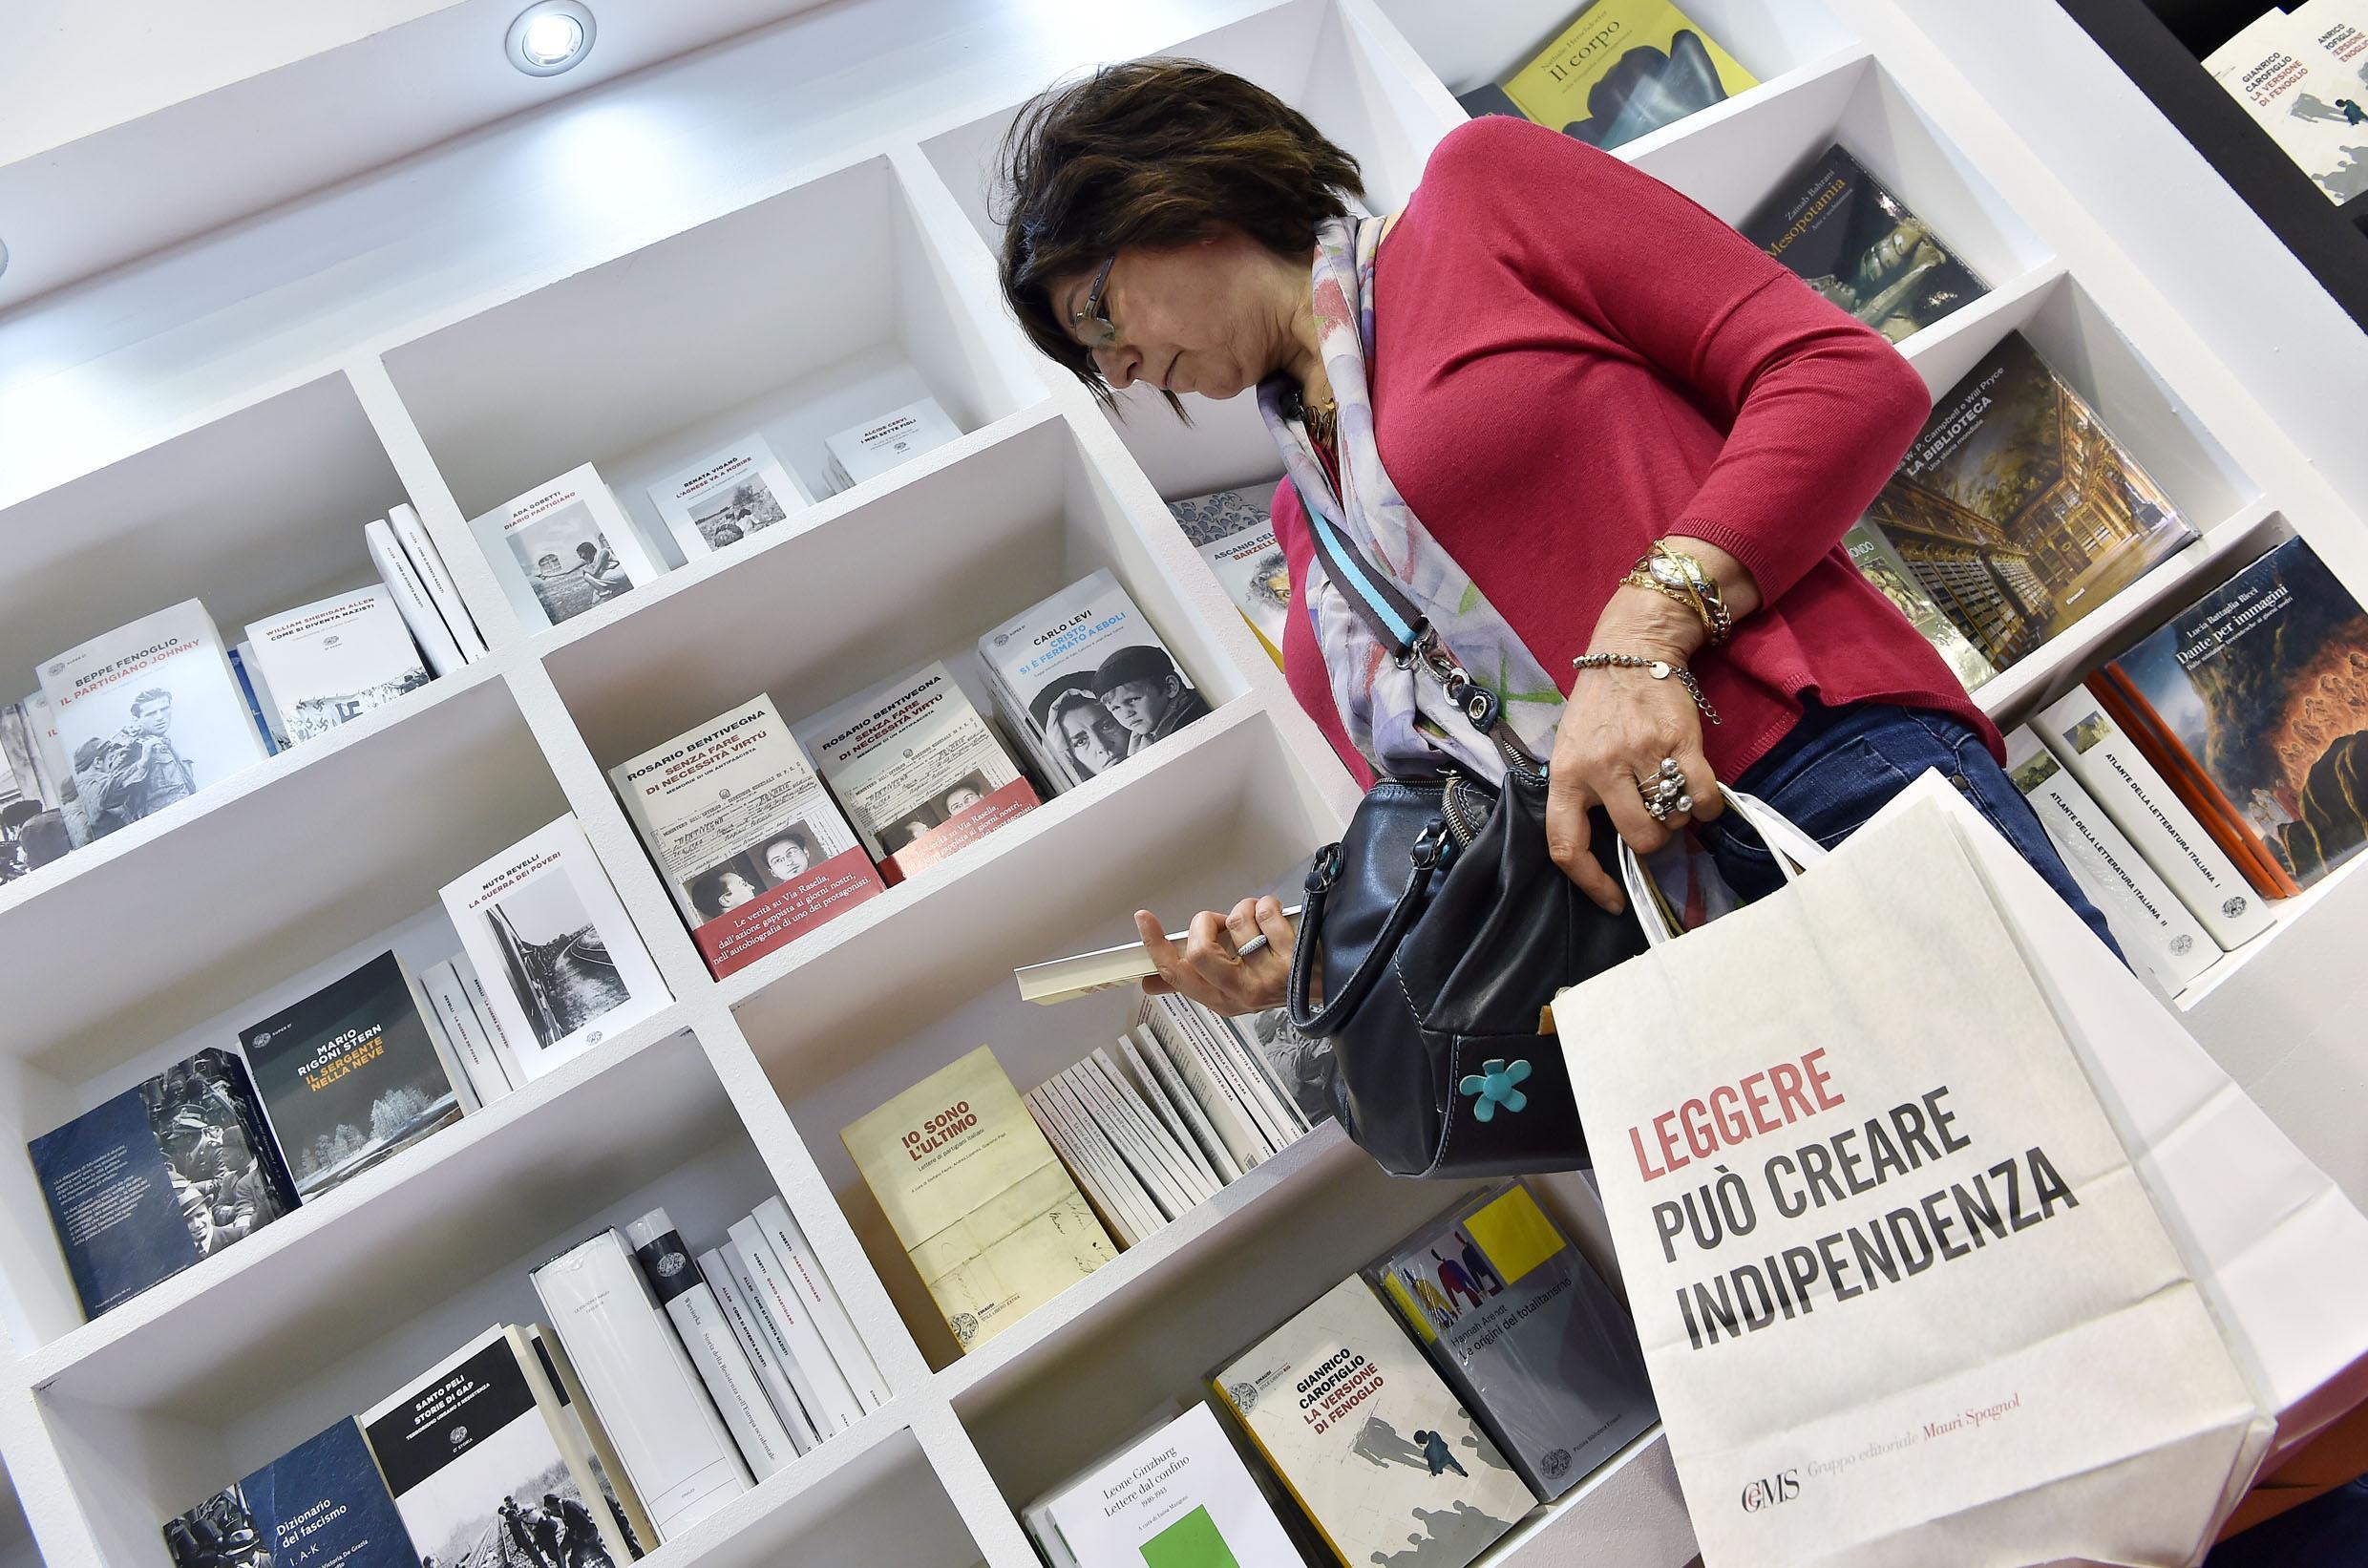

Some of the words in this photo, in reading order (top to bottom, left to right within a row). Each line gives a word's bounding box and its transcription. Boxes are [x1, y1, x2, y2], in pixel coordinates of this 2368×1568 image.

[1551, 65, 1568, 81] Il
[1570, 21, 1619, 67] corpo
[2242, 52, 2281, 83] GIANRICO
[2245, 55, 2293, 93] CAROFIGLIO
[2250, 91, 2264, 101] LA
[2262, 60, 2303, 92] VERSIONE
[2259, 98, 2271, 107] DI
[2270, 68, 2309, 102] FENOGLIO
[1905, 452, 1916, 461] W.
[1924, 408, 1960, 443] Campbell
[1965, 389, 1981, 403] Will
[1980, 368, 2004, 390] Pryce
[1907, 460, 1924, 477] LA
[1923, 396, 1993, 461] BIBLIOTECA
[676, 479, 708, 498] L'AGNESE
[726, 457, 751, 472] MORIRE
[684, 472, 710, 487] RENATA
[503, 514, 529, 530] DIARIO
[531, 492, 575, 516] PARTIGIANO
[513, 508, 528, 518] ADA
[529, 491, 560, 508] GOBETTI
[1214, 540, 1255, 561] ASCANIO
[265, 621, 302, 636] WILLIAM
[304, 606, 346, 623] SHERIDAN
[348, 598, 374, 608] ALLEN
[270, 629, 293, 641] COME
[305, 615, 340, 628] DIVENTA
[342, 604, 374, 616] NAZISTI
[1033, 624, 1067, 646] CARLO
[1068, 610, 1091, 625] LEVI
[2175, 637, 2213, 665] Dante
[2212, 623, 2234, 643] per
[2232, 583, 2289, 626] immagini
[2187, 623, 2209, 638] Lucia
[2207, 601, 2239, 625] Battaglia
[2238, 586, 2258, 604] Ricci
[1020, 665, 1030, 674] SI
[1031, 660, 1039, 668] È
[1039, 633, 1086, 663] FERMATO
[1096, 612, 1126, 631] EBOLI
[1050, 625, 1086, 647] CRISTO
[60, 697, 72, 706] IL
[74, 661, 147, 699] PARTIGIANO
[152, 638, 199, 664] JOHNNY
[74, 665, 114, 688] BEPPE
[116, 638, 178, 667] FENOGLIO
[48, 729, 57, 737] IL
[822, 718, 871, 751] ROSARIO
[873, 676, 941, 719] BENTIVEGNA
[838, 751, 851, 760] DI
[852, 714, 911, 752] NECESSITÀ
[855, 718, 891, 742] SENZA
[891, 700, 920, 719] FARE
[626, 750, 684, 781] ROSARIO
[686, 710, 766, 752] BENTIVEGNA
[665, 752, 707, 775] SENZA
[708, 733, 740, 753] FARE
[645, 784, 660, 795] DI
[661, 750, 729, 787] NECESSITÀ
[2105, 752, 2132, 784] ATLANTE
[2130, 782, 2150, 806] DELLA
[2149, 805, 2189, 853] LETTERATURA
[2188, 851, 2215, 883] ITALIANA
[468, 900, 479, 908] LA
[481, 879, 514, 901] GUERRA
[516, 869, 529, 880] DEI
[531, 851, 560, 872] POVERI
[482, 875, 504, 890] NUTO
[506, 854, 539, 876] REVELLI
[2050, 792, 2078, 821] ATLANTE
[2076, 820, 2095, 844] DELLA
[2094, 842, 2135, 890] LETTERATURA
[2133, 888, 2161, 920] ITALIANA
[712, 924, 781, 964] nell'autobiografia
[782, 917, 792, 926] di
[792, 910, 808, 922] uno
[809, 902, 821, 912] dei
[822, 878, 871, 907] protagonisti.
[718, 923, 761, 950] dall'azione
[762, 905, 794, 927] gappista
[795, 898, 804, 907] ai
[805, 885, 829, 906] giorni
[830, 872, 856, 889] nostri,
[733, 919, 746, 927] Le
[747, 904, 771, 921] verità
[772, 900, 782, 908] su
[781, 891, 797, 901] Via
[797, 876, 829, 894] Rasella,
[297, 1047, 341, 1075] RIGONI
[343, 1024, 381, 1050] STERN
[306, 1074, 318, 1084] IL
[321, 1036, 382, 1076] SERGENTE
[317, 1029, 357, 1055] MARIO
[311, 1066, 350, 1091] NELLA
[351, 1045, 384, 1069] NEVE
[901, 1131, 920, 1148] IO
[923, 1101, 969, 1134] SONO
[908, 1113, 977, 1161] L'ULTIMO
[1628, 1047, 1845, 1183] LEGGERE
[1652, 1164, 1757, 1263] PUÒ
[1764, 1085, 1972, 1218] CREARE
[1675, 1146, 2080, 1350] INDIPENDENZA
[1451, 1322, 1482, 1346] Hannah
[1482, 1304, 1509, 1326] Arendt
[1459, 1348, 1473, 1360] Le
[1474, 1325, 1505, 1350] origini
[1503, 1314, 1518, 1329] del
[1517, 1278, 1572, 1320] totalitarismo
[415, 1388, 444, 1410] SANTO
[445, 1374, 464, 1390] PELI
[1297, 1348, 1350, 1392] GIANRICO
[1299, 1355, 1364, 1409] CAROFIGLIO
[1303, 1408, 1321, 1424] LA
[1320, 1362, 1378, 1409] VERSIONE
[414, 1400, 445, 1425] STORIE
[445, 1393, 455, 1404] DI
[455, 1381, 474, 1396] GAP
[1313, 1419, 1329, 1434] DI
[1327, 1376, 1384, 1423] FENOGLIO
[1808, 1454, 1855, 1477] Gruppo
[1859, 1432, 1919, 1461] editoriale
[1922, 1413, 1963, 1440] Mauri
[1965, 1392, 2021, 1427] Spagnol
[1103, 1476, 1131, 1499] Leone
[1132, 1447, 1176, 1478] Ginzburg
[1104, 1492, 1136, 1516] Lettere
[1138, 1477, 1153, 1494] dal
[1154, 1456, 1189, 1483] confino
[276, 1499, 330, 1536] Dizionario
[283, 1531, 299, 1548] del
[300, 1505, 347, 1536] fascismo
[300, 1542, 319, 1561] A-K
